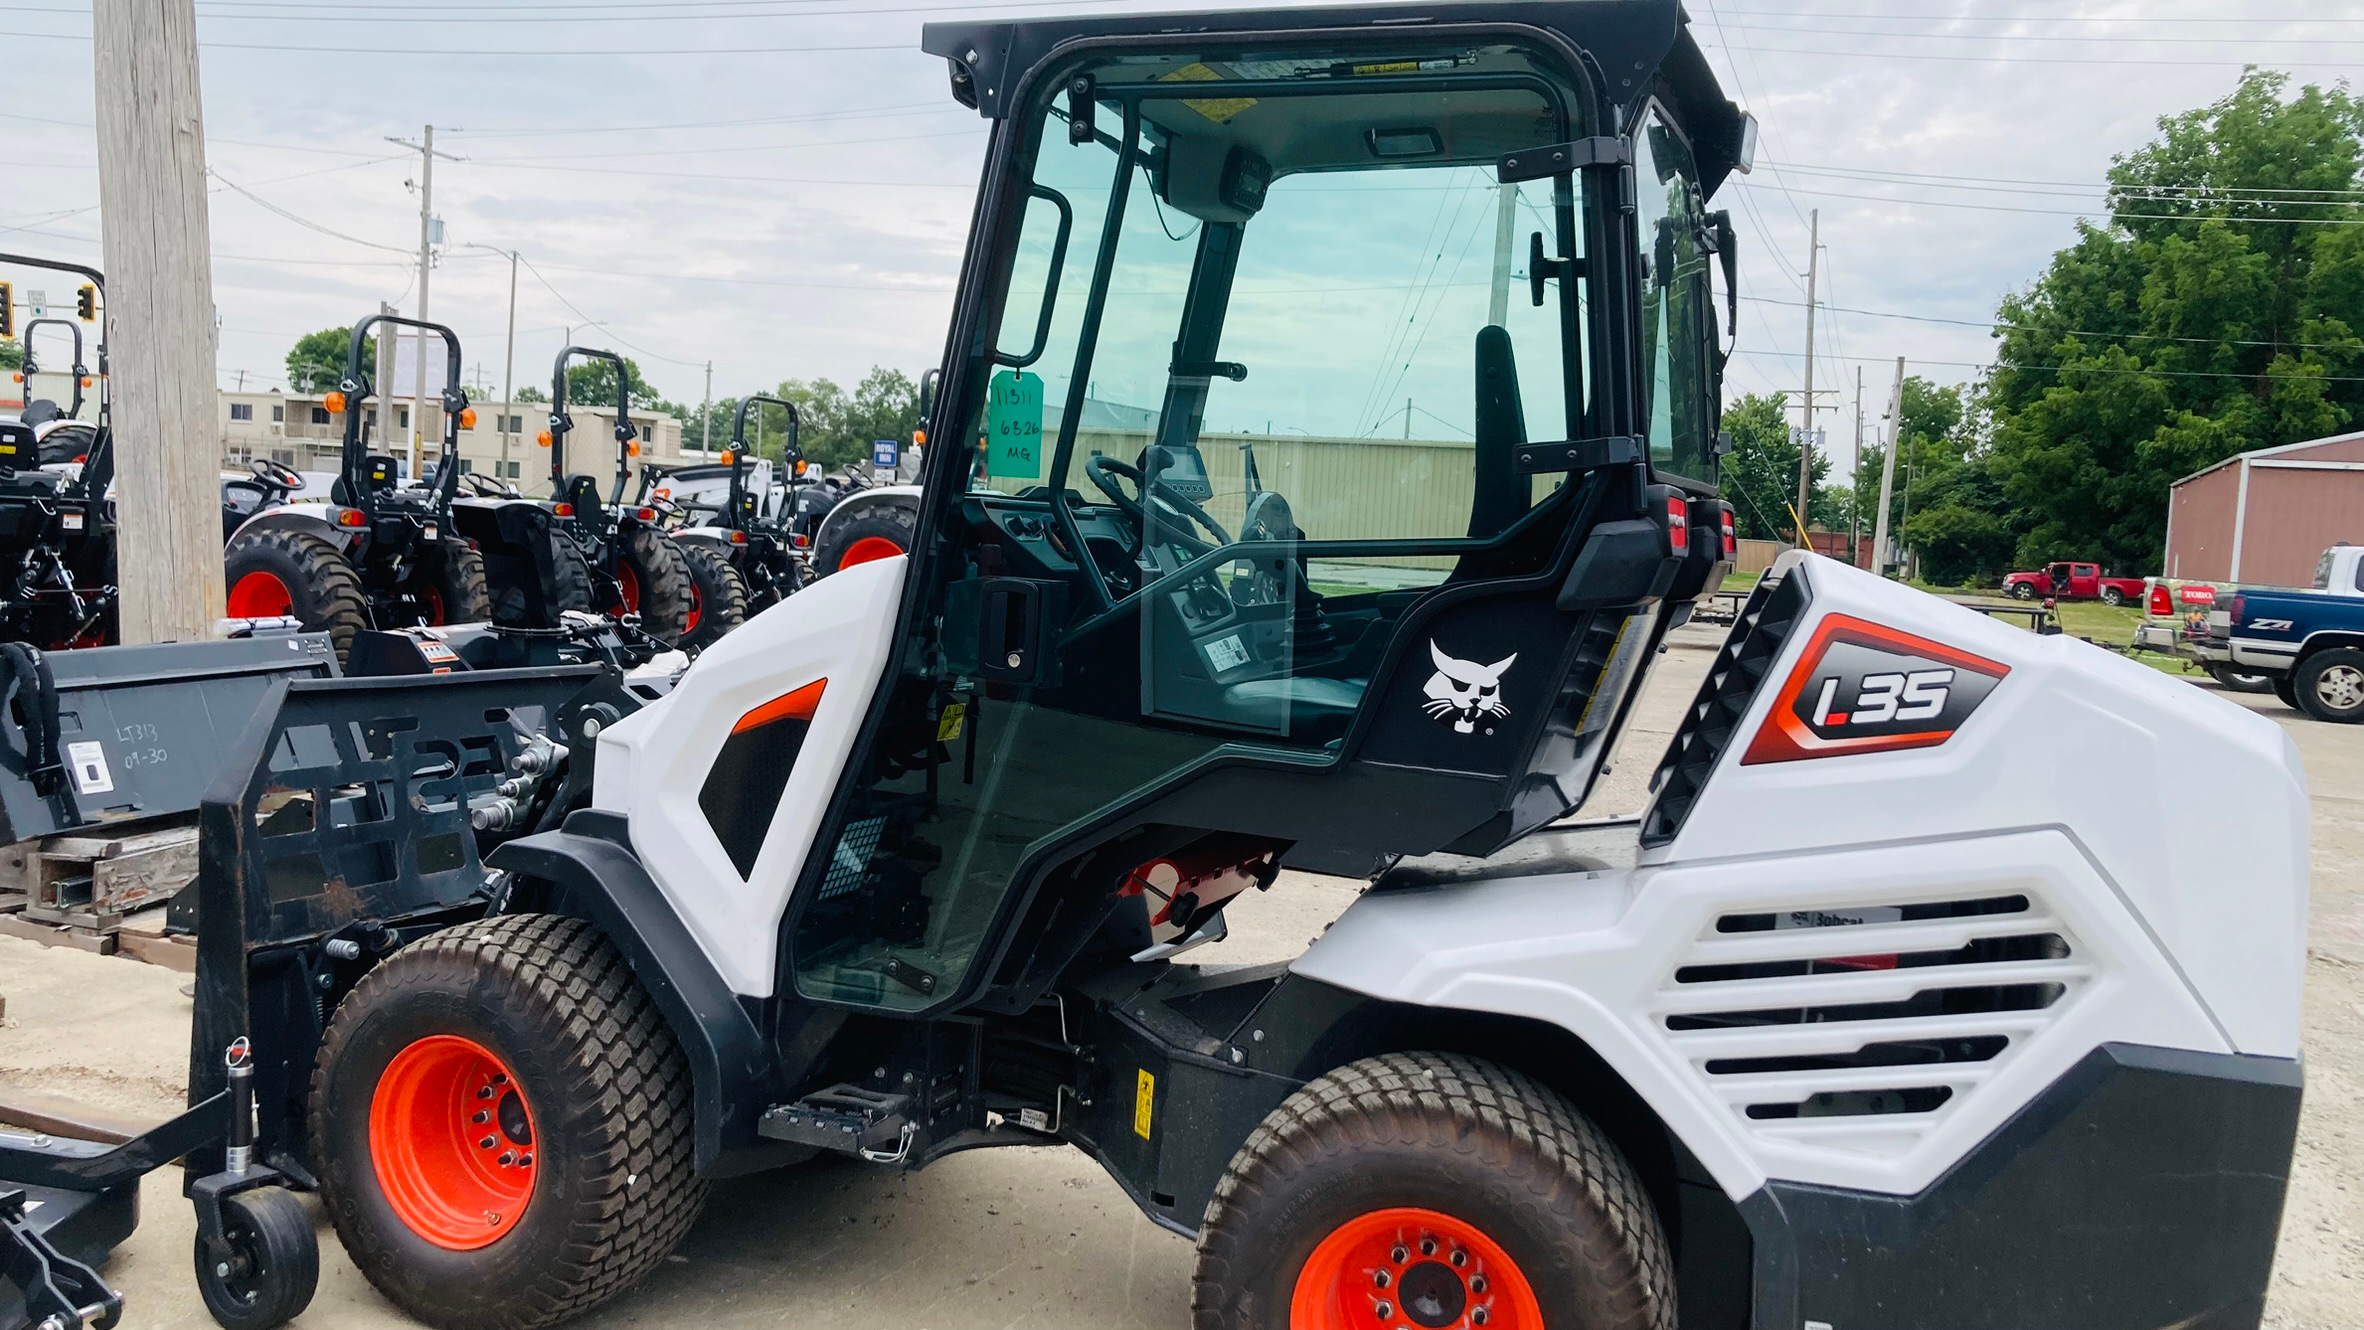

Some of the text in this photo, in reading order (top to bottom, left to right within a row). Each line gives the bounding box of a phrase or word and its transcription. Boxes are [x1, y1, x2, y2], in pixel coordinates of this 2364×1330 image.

[996, 386, 1032, 406] 11311
[1000, 420, 1040, 436] 6326
[876, 443, 895, 453] ROYAL
[1007, 447, 1031, 462] MG
[879, 453, 892, 463] INN
[1812, 668, 1956, 727] L35
[116, 723, 158, 743] LT313
